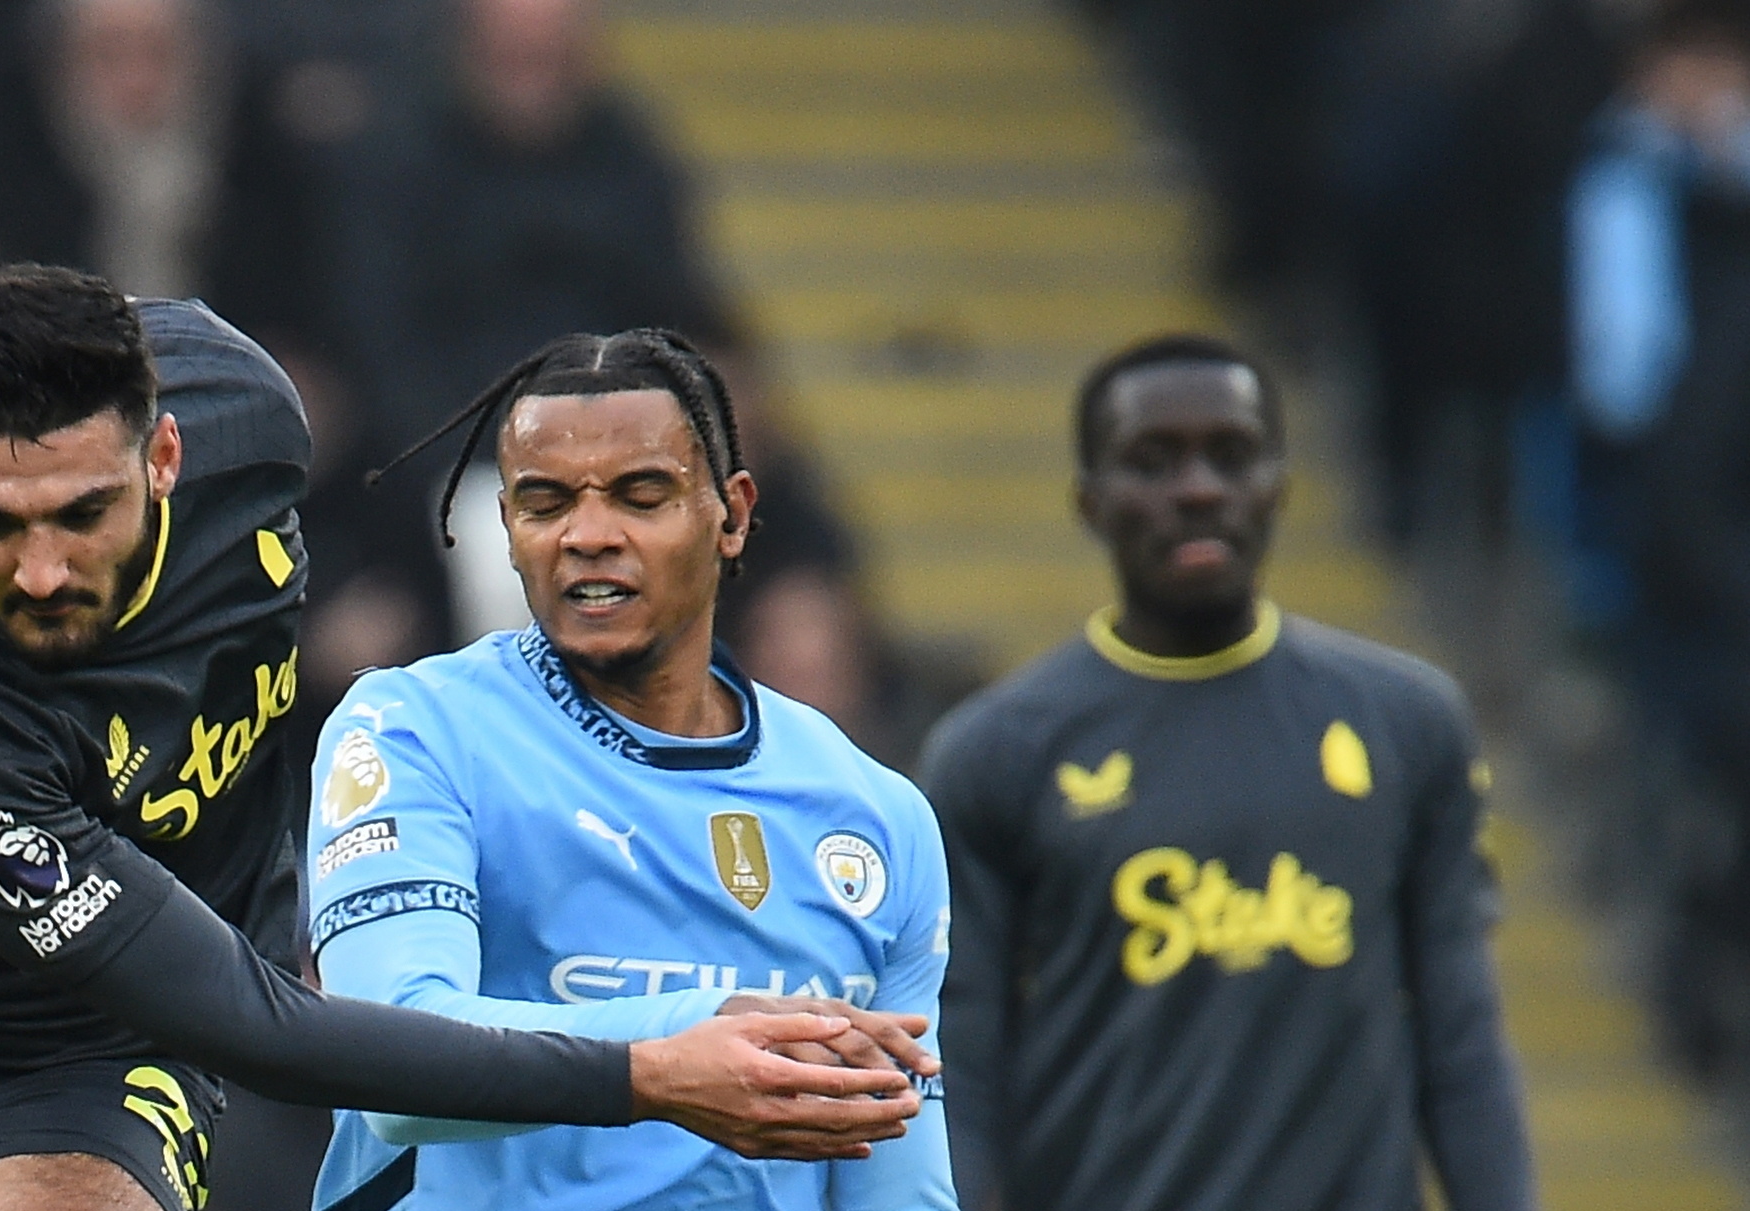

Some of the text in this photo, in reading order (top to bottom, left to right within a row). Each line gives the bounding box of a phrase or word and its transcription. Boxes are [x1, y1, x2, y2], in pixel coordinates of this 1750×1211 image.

[336, 822, 390, 855] room
[18, 873, 103, 943] No room
[30, 879, 122, 958] for racism
[1112, 846, 1354, 986] Stake
